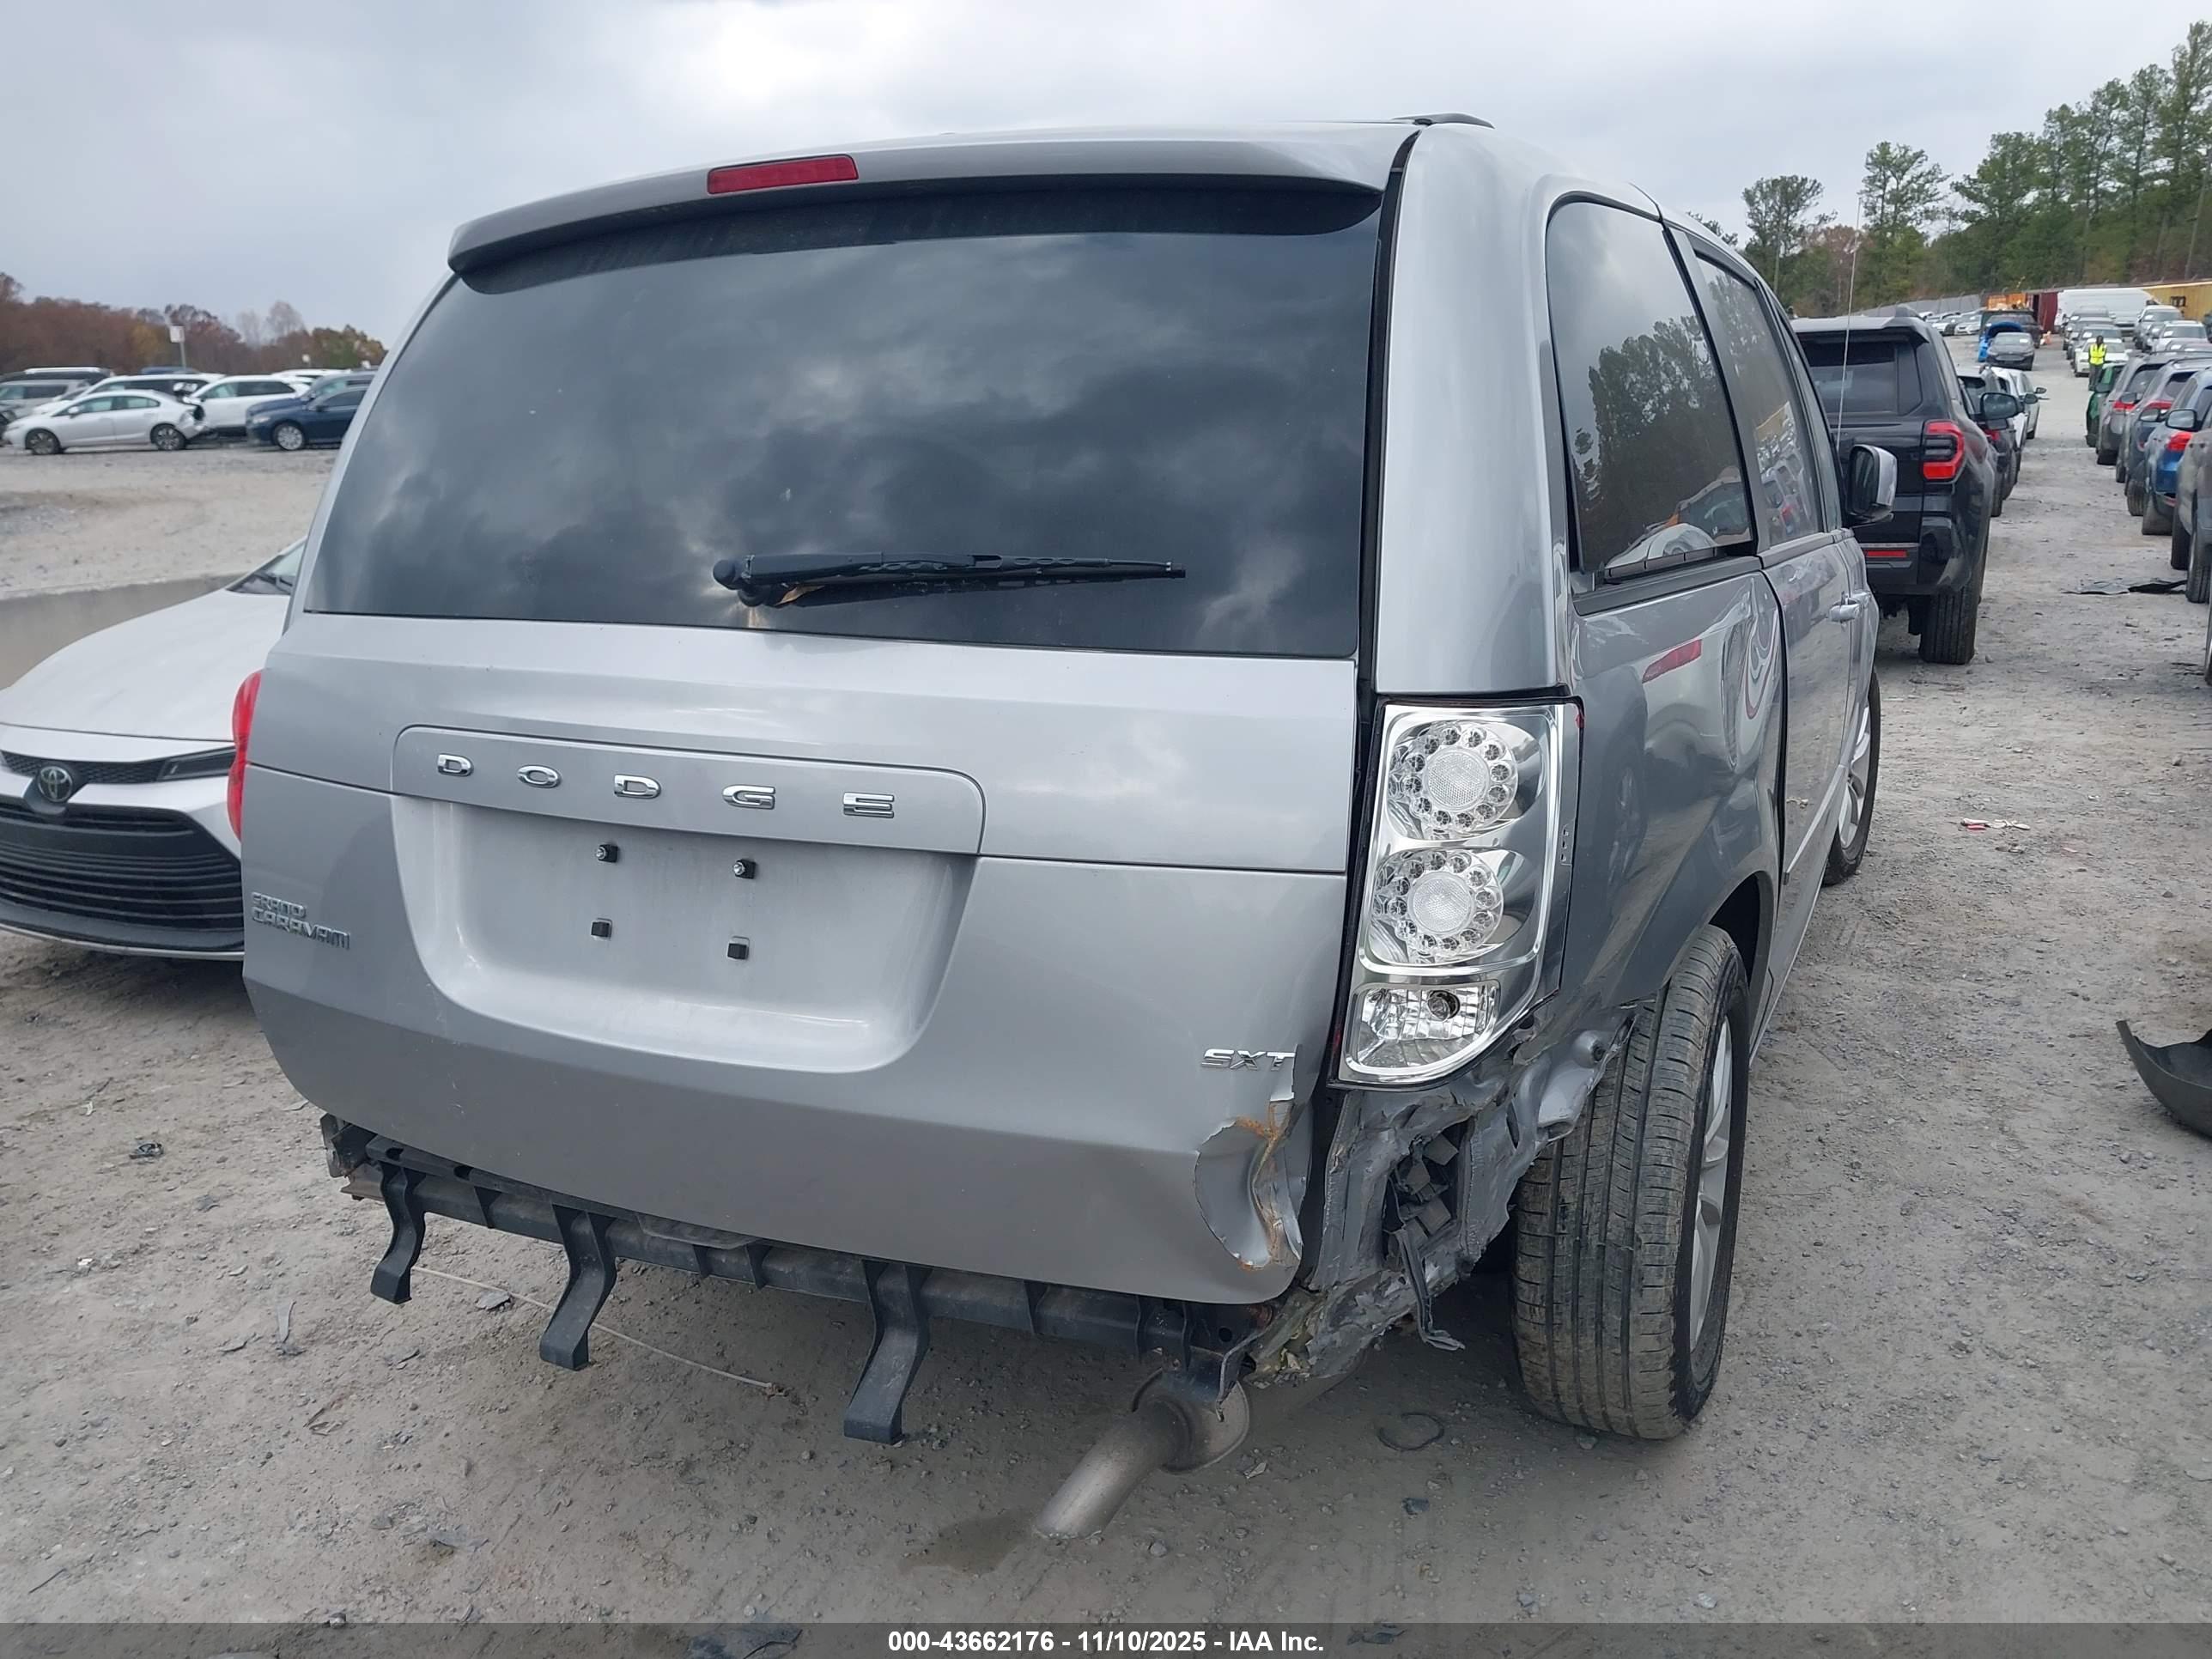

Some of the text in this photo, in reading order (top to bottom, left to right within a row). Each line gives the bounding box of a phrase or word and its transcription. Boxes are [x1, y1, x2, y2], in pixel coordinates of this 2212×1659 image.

[437, 754, 895, 818] DODGE
[252, 891, 307, 919] GRAND
[252, 906, 350, 950] CARAVAN
[1201, 1048, 1296, 1071] SXT
